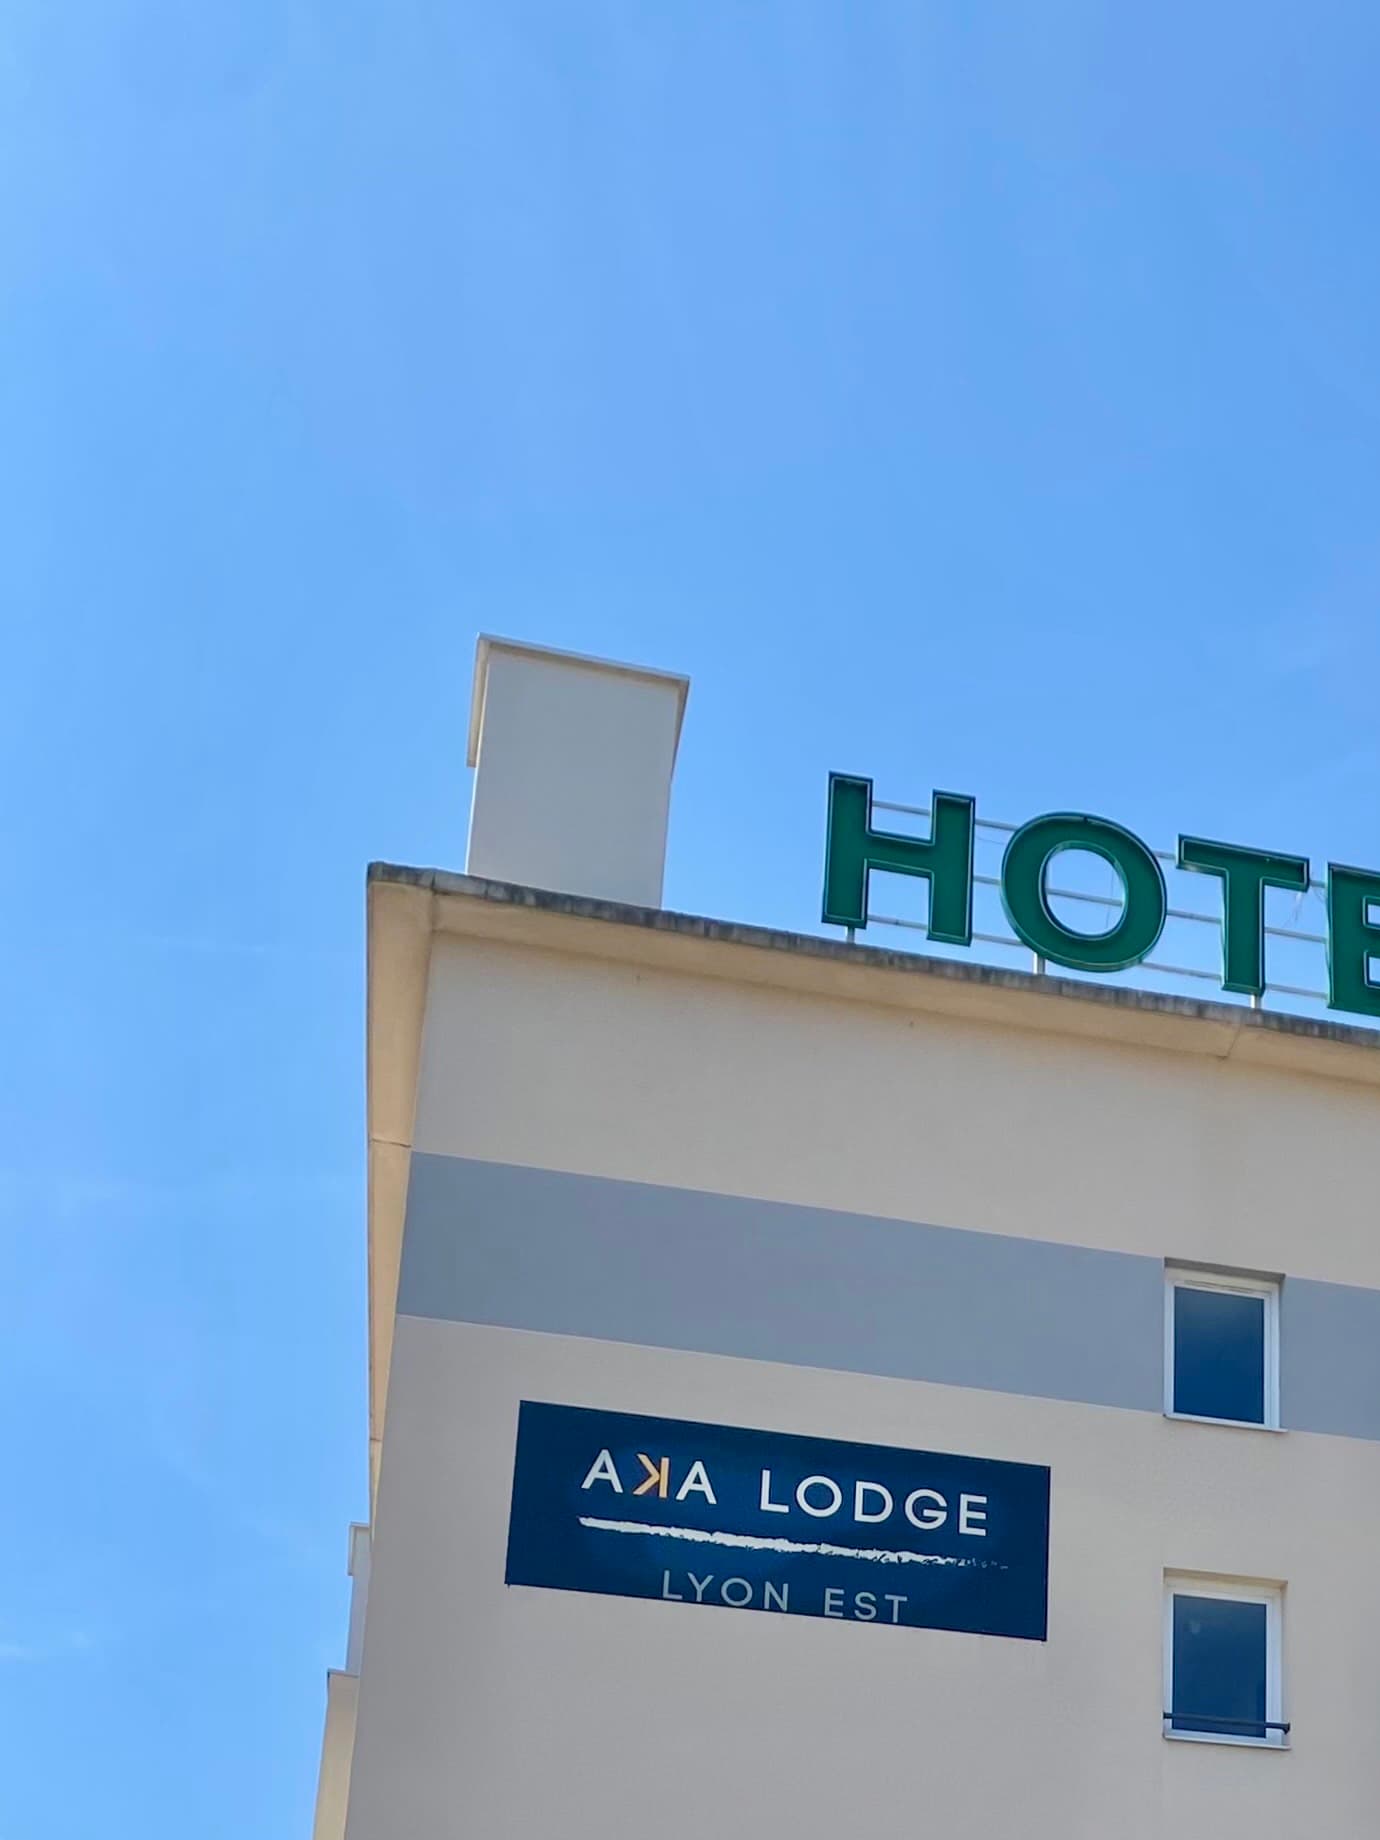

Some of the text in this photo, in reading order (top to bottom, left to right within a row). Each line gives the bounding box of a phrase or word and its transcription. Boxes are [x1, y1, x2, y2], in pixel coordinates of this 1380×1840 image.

[581, 1448, 988, 1536] AKA LODGE
[662, 1570, 908, 1623] LYON EST
